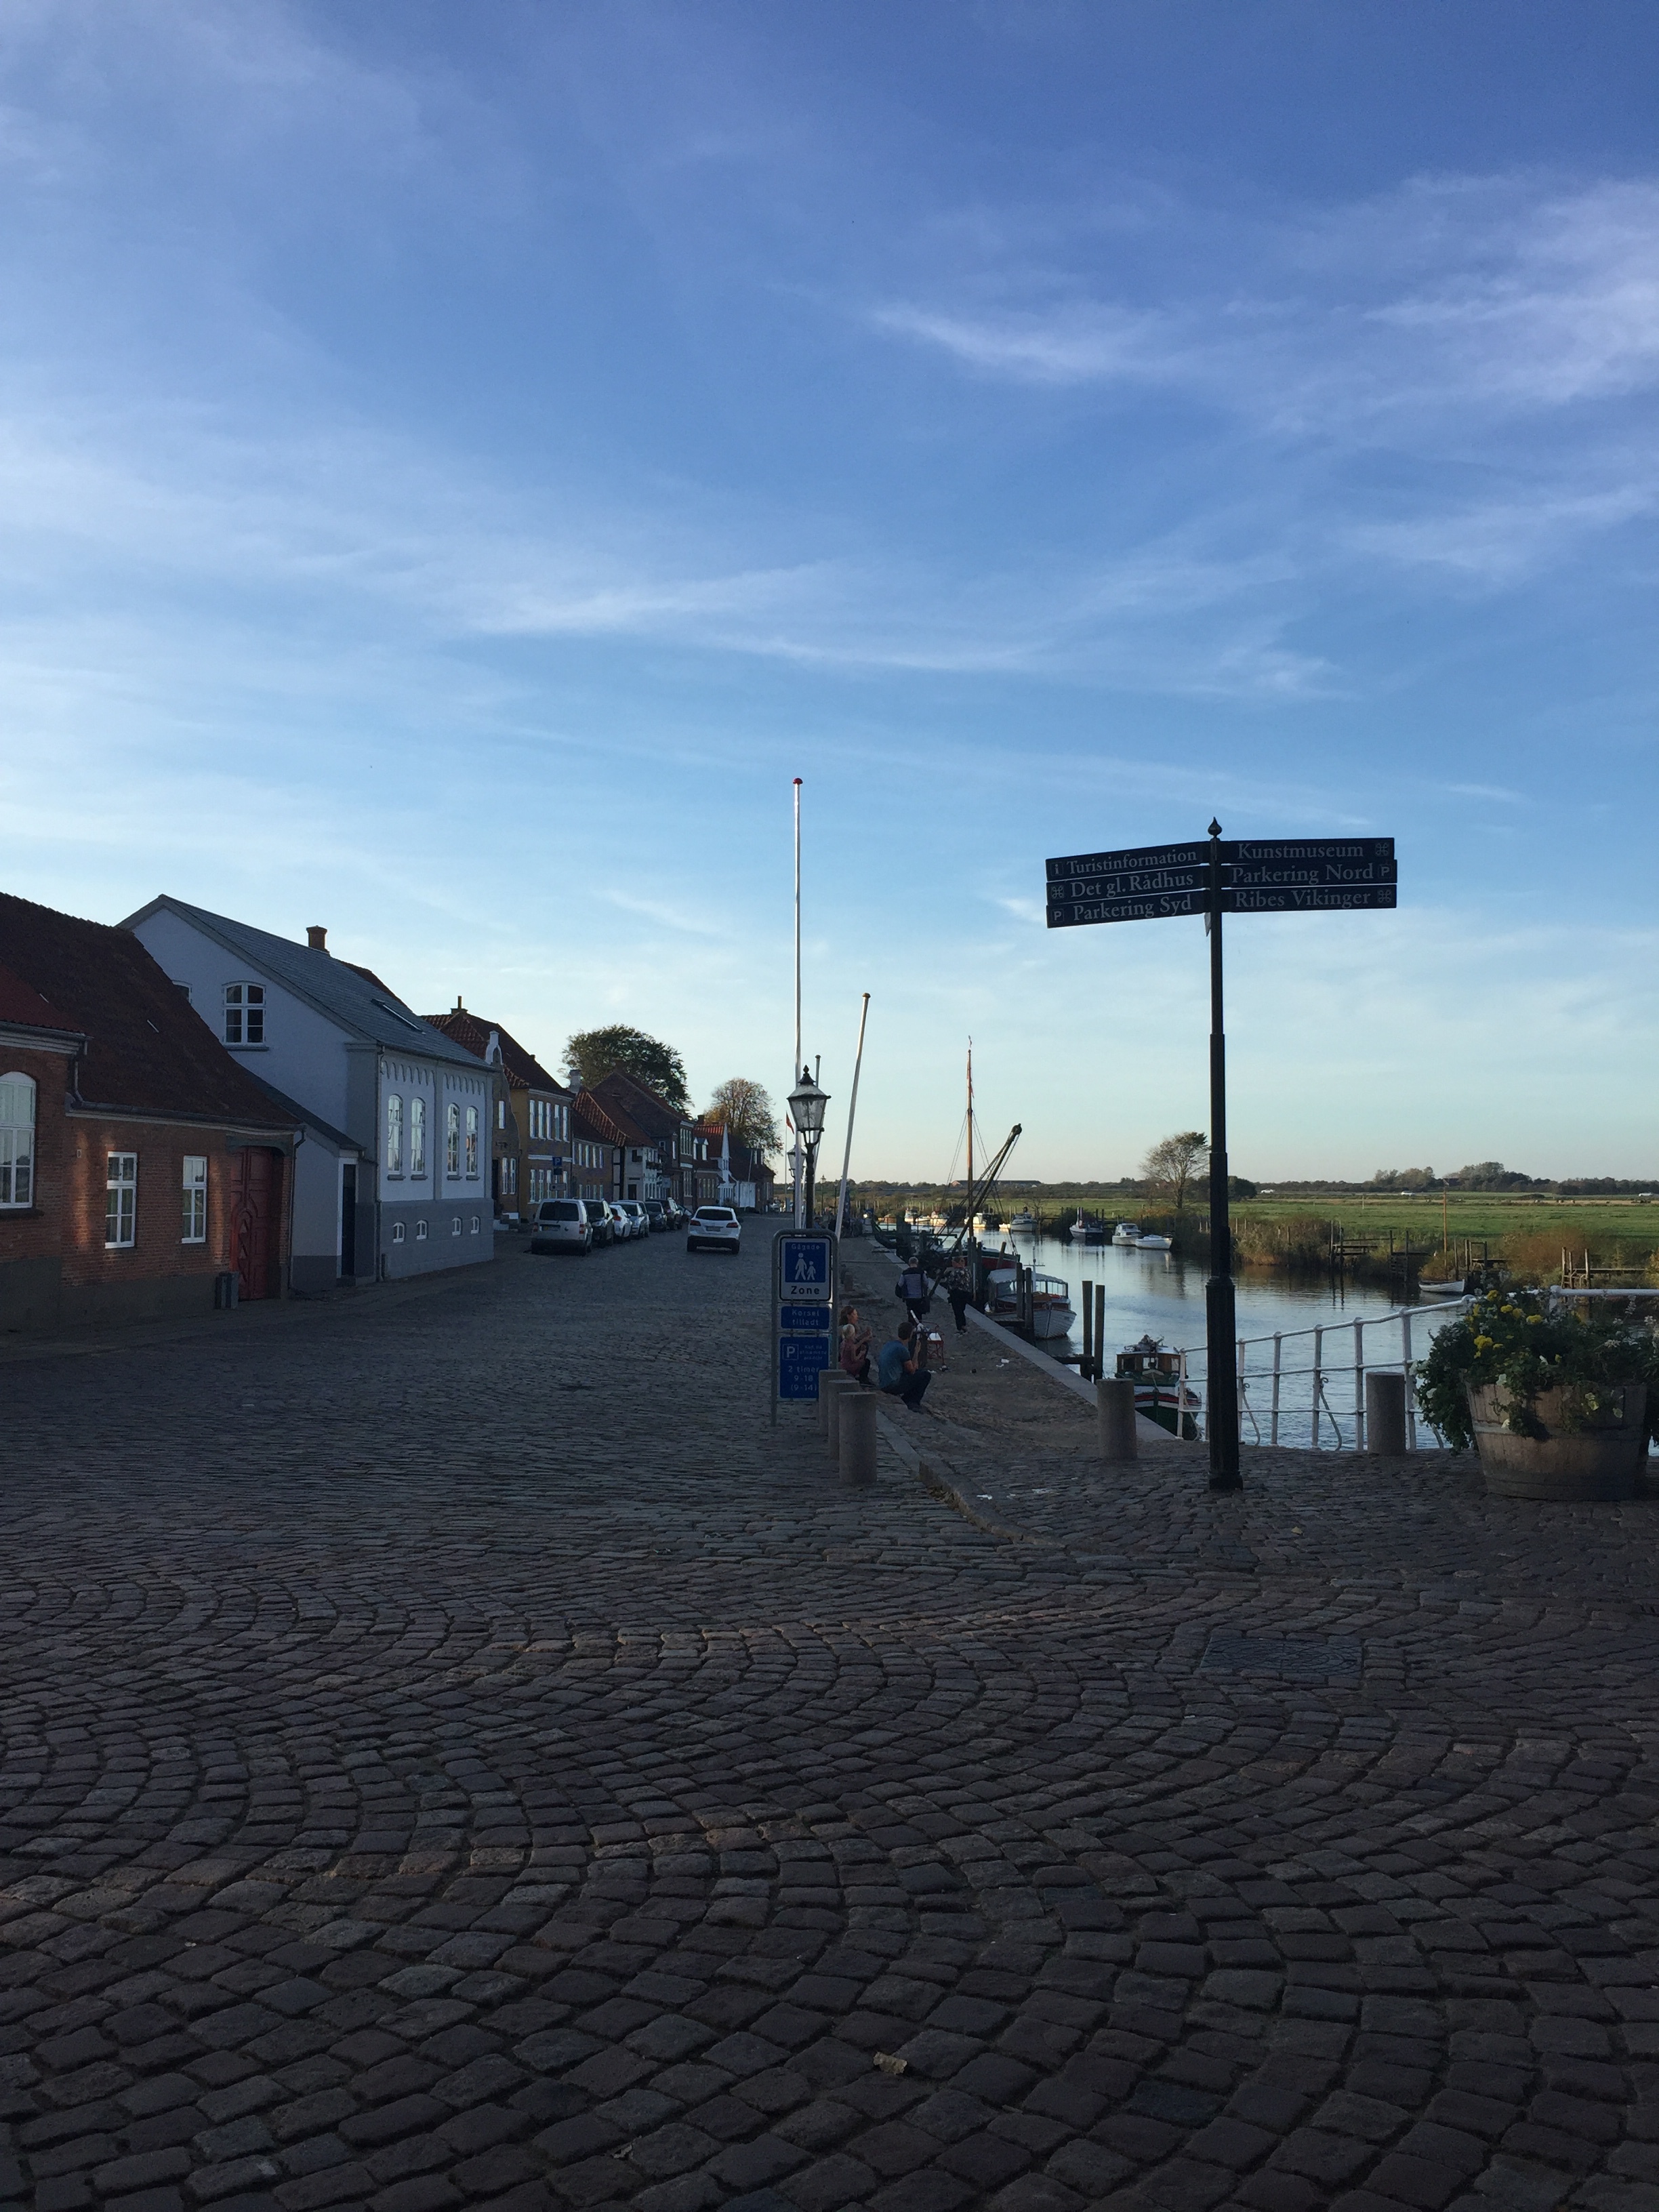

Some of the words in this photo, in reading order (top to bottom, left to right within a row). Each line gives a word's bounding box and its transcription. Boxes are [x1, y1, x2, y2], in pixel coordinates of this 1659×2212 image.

[1237, 842, 1364, 859] Kunstmuseum
[1067, 849, 1197, 875] Turistinformation
[1231, 865, 1319, 885] Parkering
[1325, 863, 1374, 880] Nord
[1071, 881, 1101, 898] Det
[1106, 877, 1126, 898] gl.
[1129, 872, 1193, 892] Rådhus
[1073, 899, 1154, 921] Parkering
[1160, 894, 1192, 914] Syd
[1235, 890, 1285, 907] Ribes
[1290, 888, 1370, 909] Vikinger
[791, 1243, 820, 1251] Gågade
[791, 1286, 820, 1294] Zone
[786, 1346, 796, 1358] P
